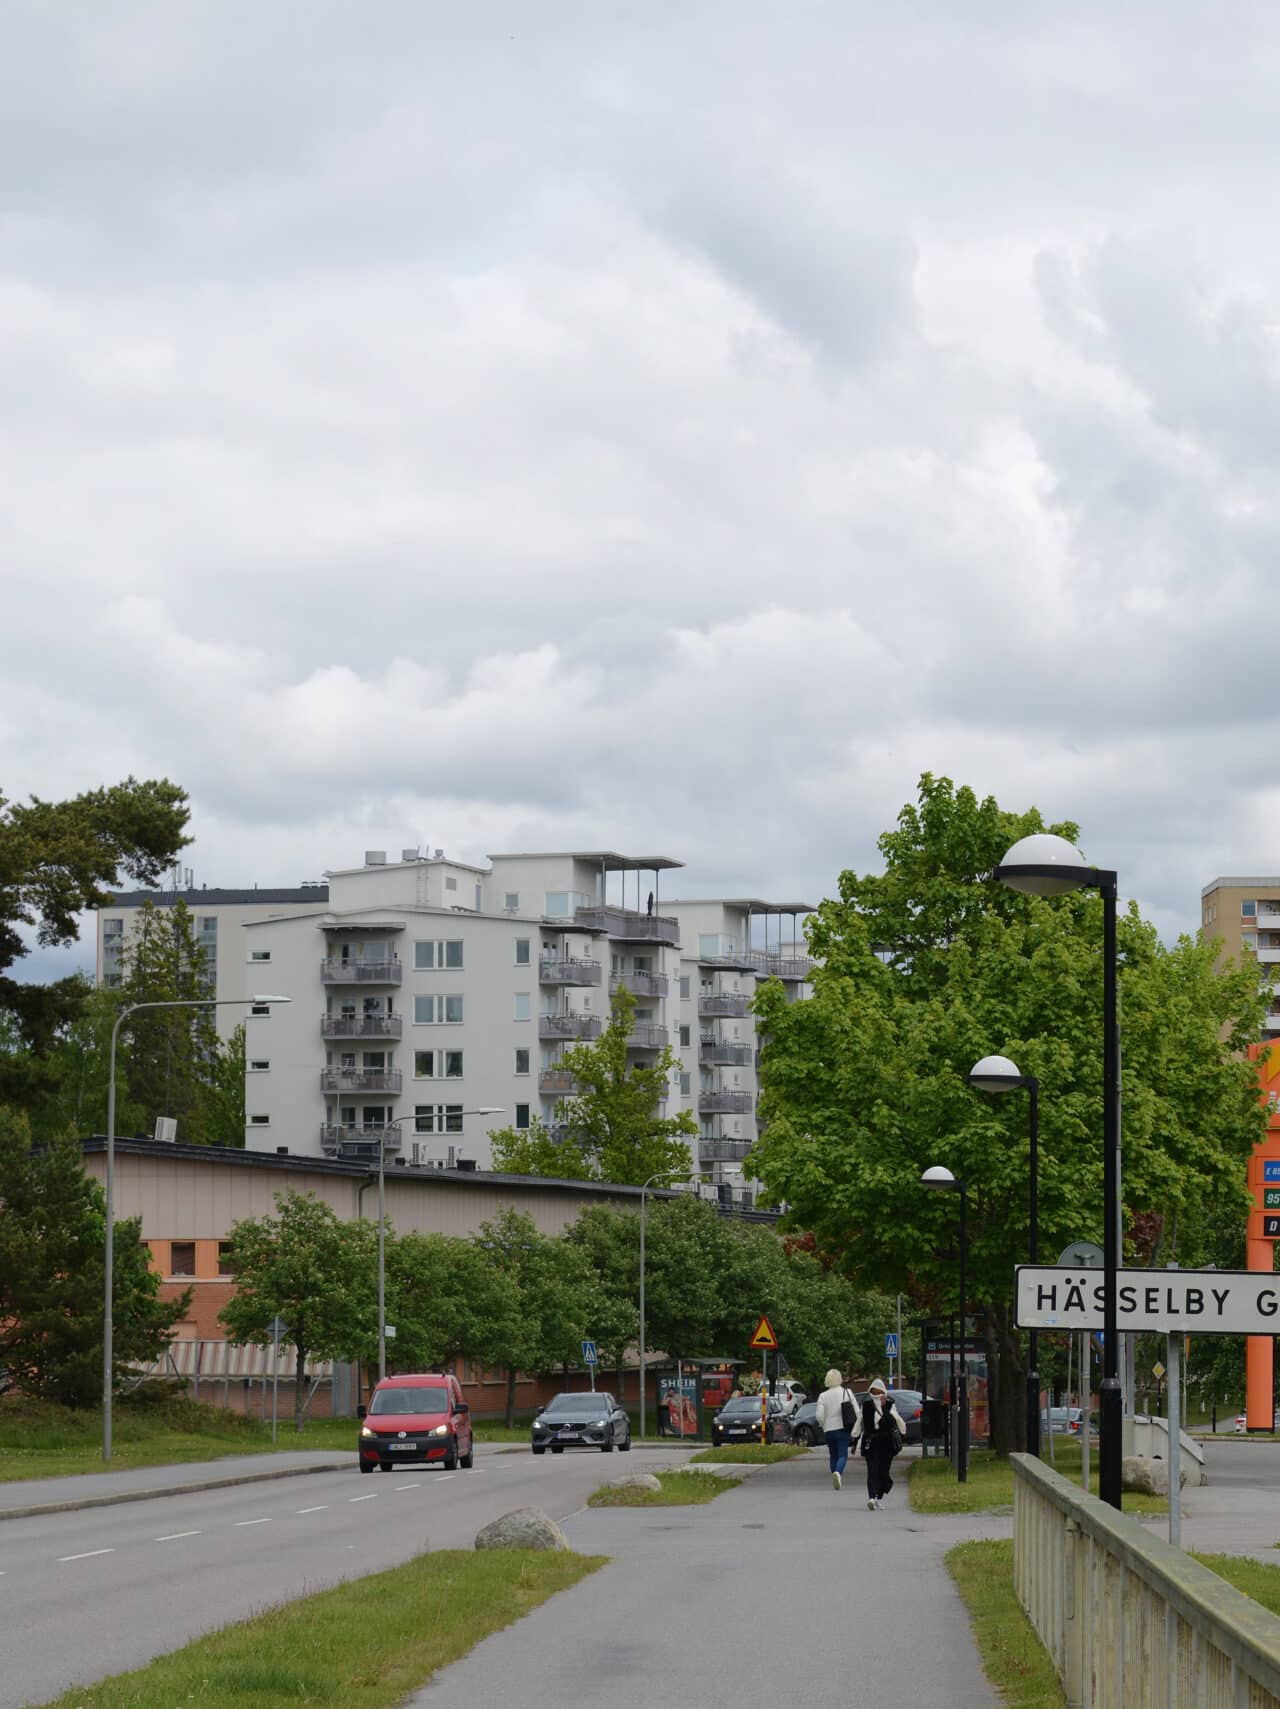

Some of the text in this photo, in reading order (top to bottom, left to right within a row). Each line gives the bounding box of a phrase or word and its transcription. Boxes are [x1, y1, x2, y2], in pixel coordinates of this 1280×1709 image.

[1266, 1193, 1280, 1204] 95
[1269, 1220, 1279, 1232] D
[1036, 1278, 1231, 1316] HÄSSELBY
[660, 1378, 696, 1388] SHEIN
